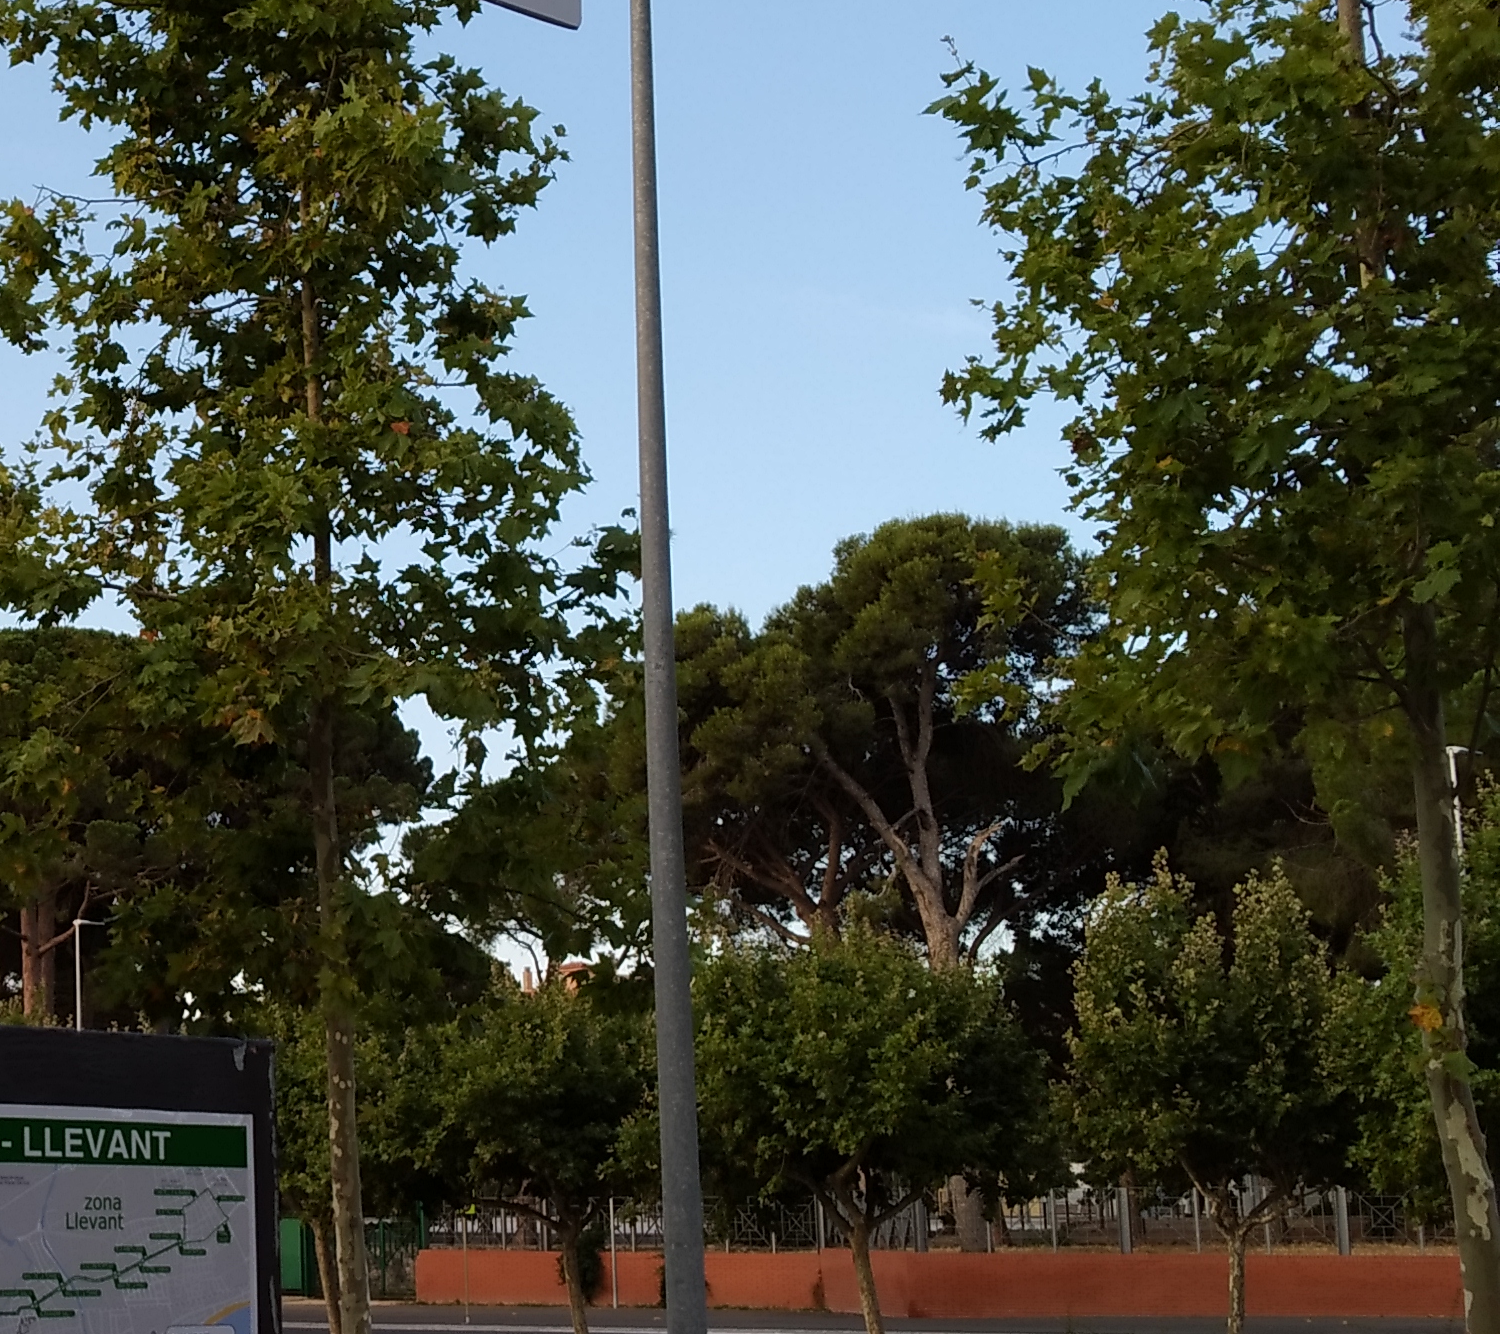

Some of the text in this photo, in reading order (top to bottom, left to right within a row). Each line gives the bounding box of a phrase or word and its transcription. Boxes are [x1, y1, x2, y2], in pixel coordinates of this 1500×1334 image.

[23, 1126, 171, 1160] LLEVANT
[84, 1196, 121, 1210] zona
[66, 1212, 123, 1230] Llevant
